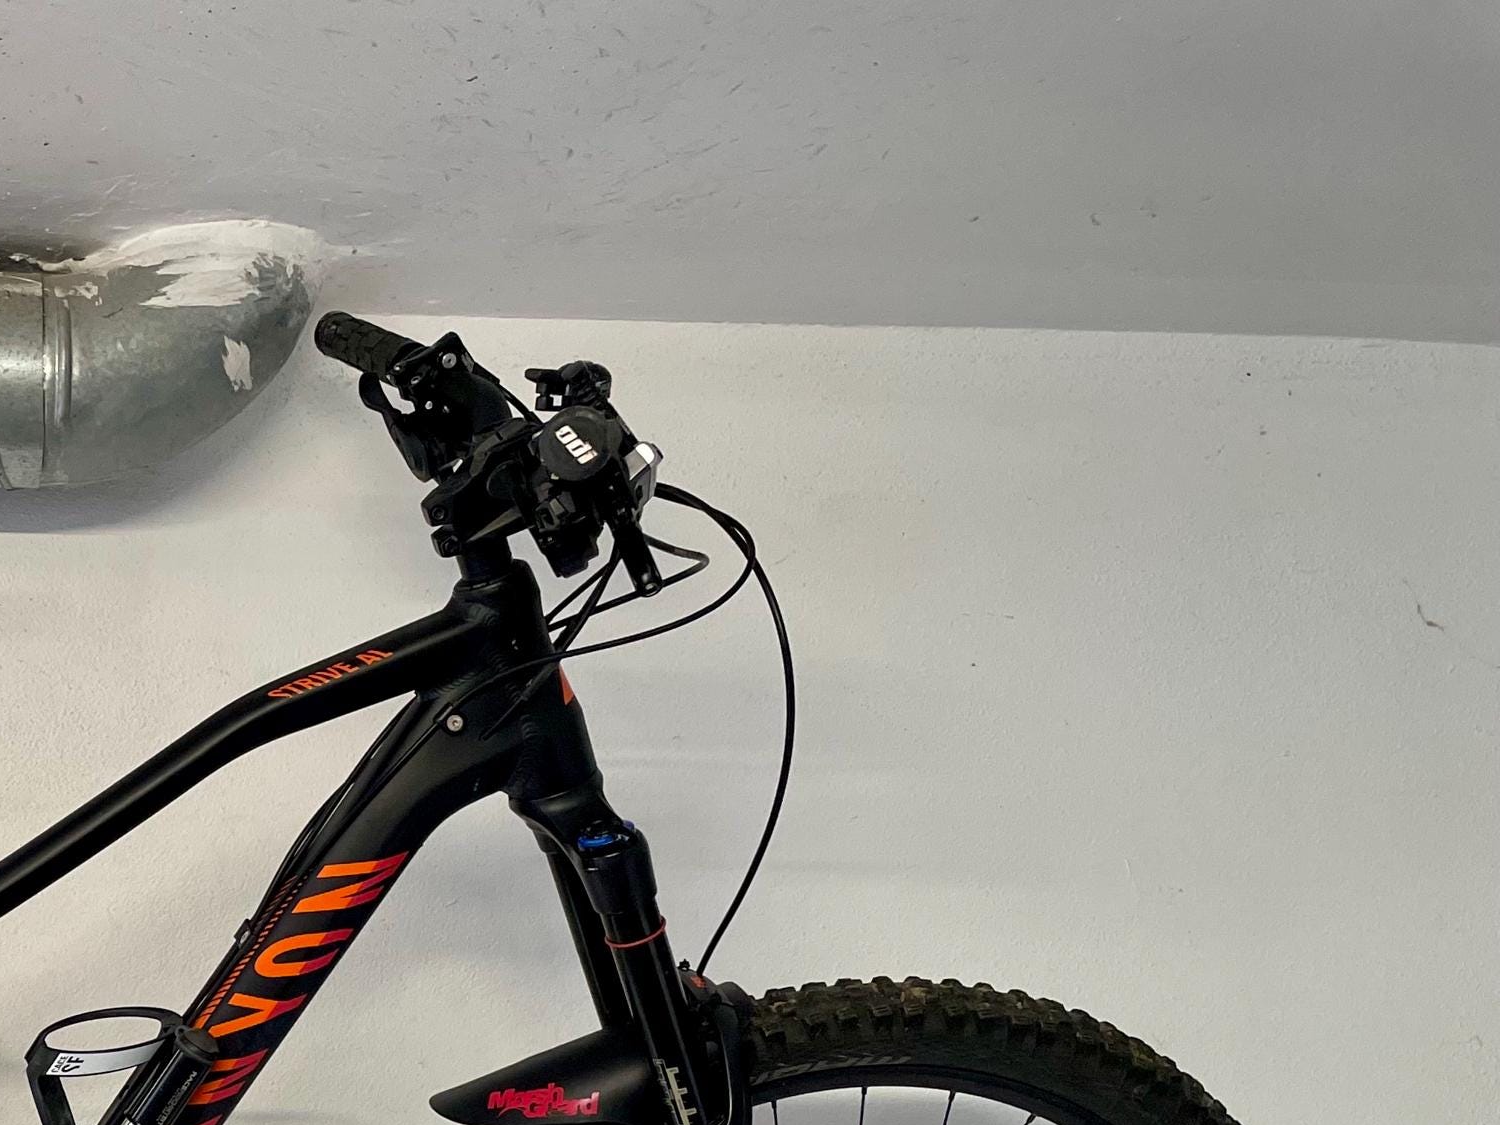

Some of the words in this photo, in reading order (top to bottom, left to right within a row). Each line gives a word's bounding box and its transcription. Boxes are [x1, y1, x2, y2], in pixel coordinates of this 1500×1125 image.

[555, 424, 598, 464] odi
[268, 662, 360, 698] STRIVE
[356, 649, 393, 666] AL
